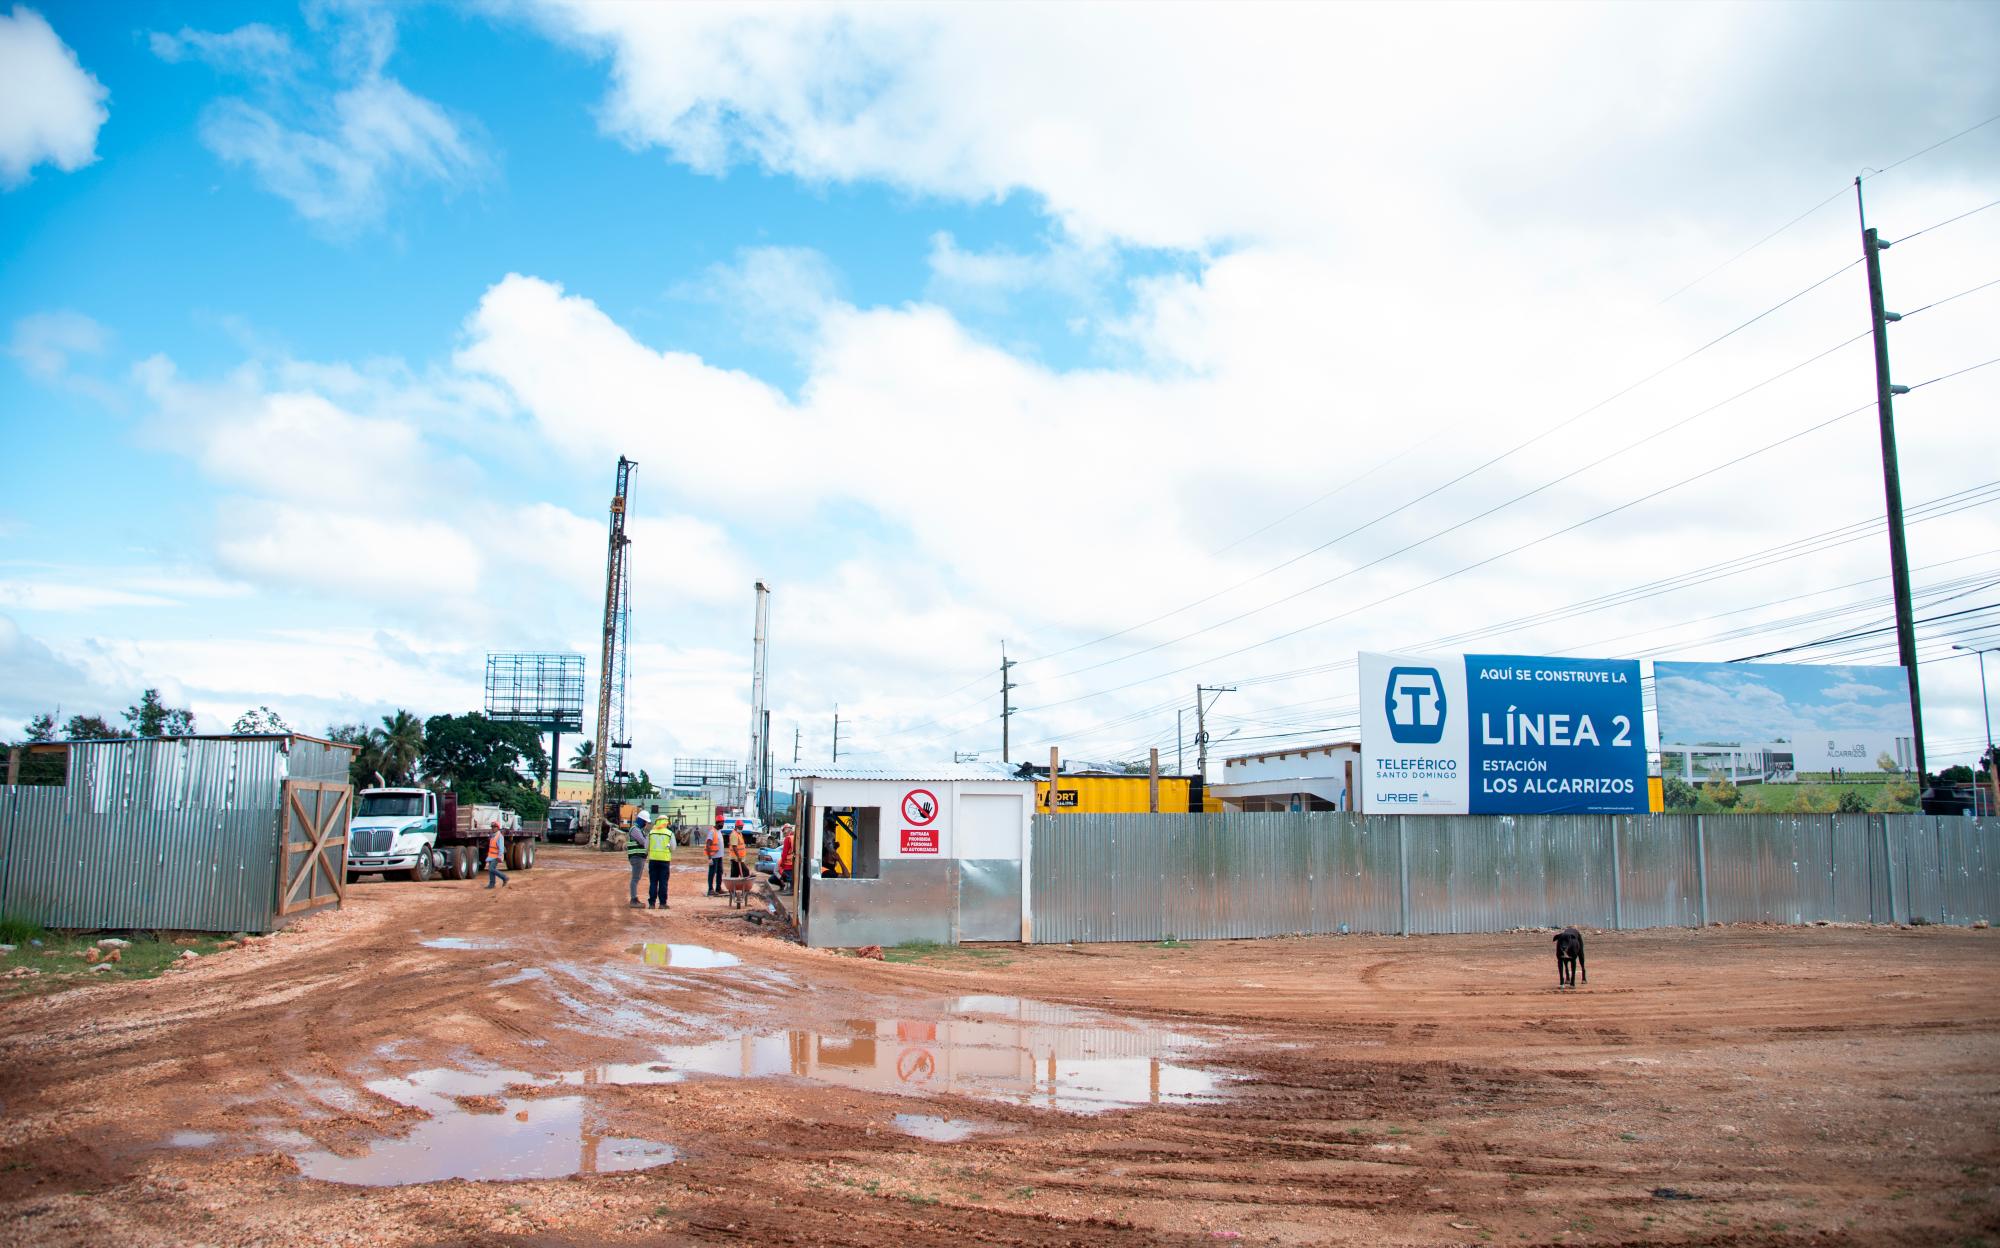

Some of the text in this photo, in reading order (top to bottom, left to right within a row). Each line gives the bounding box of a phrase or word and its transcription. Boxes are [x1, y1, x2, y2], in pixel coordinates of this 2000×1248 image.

[1480, 667, 1627, 683] AQUÍ SE CONSTRUYE LA
[1482, 704, 1632, 747] LÍNEA 2
[1827, 750, 1867, 758] ALCARRIZOS
[1376, 756, 1457, 770] TELEFÉRICO
[1483, 758, 1547, 772] ESTACIÓN
[1376, 771, 1408, 779] SANTO
[1483, 778, 1635, 794] LOS ALCARRIZOS
[1376, 793, 1418, 802] URBE
